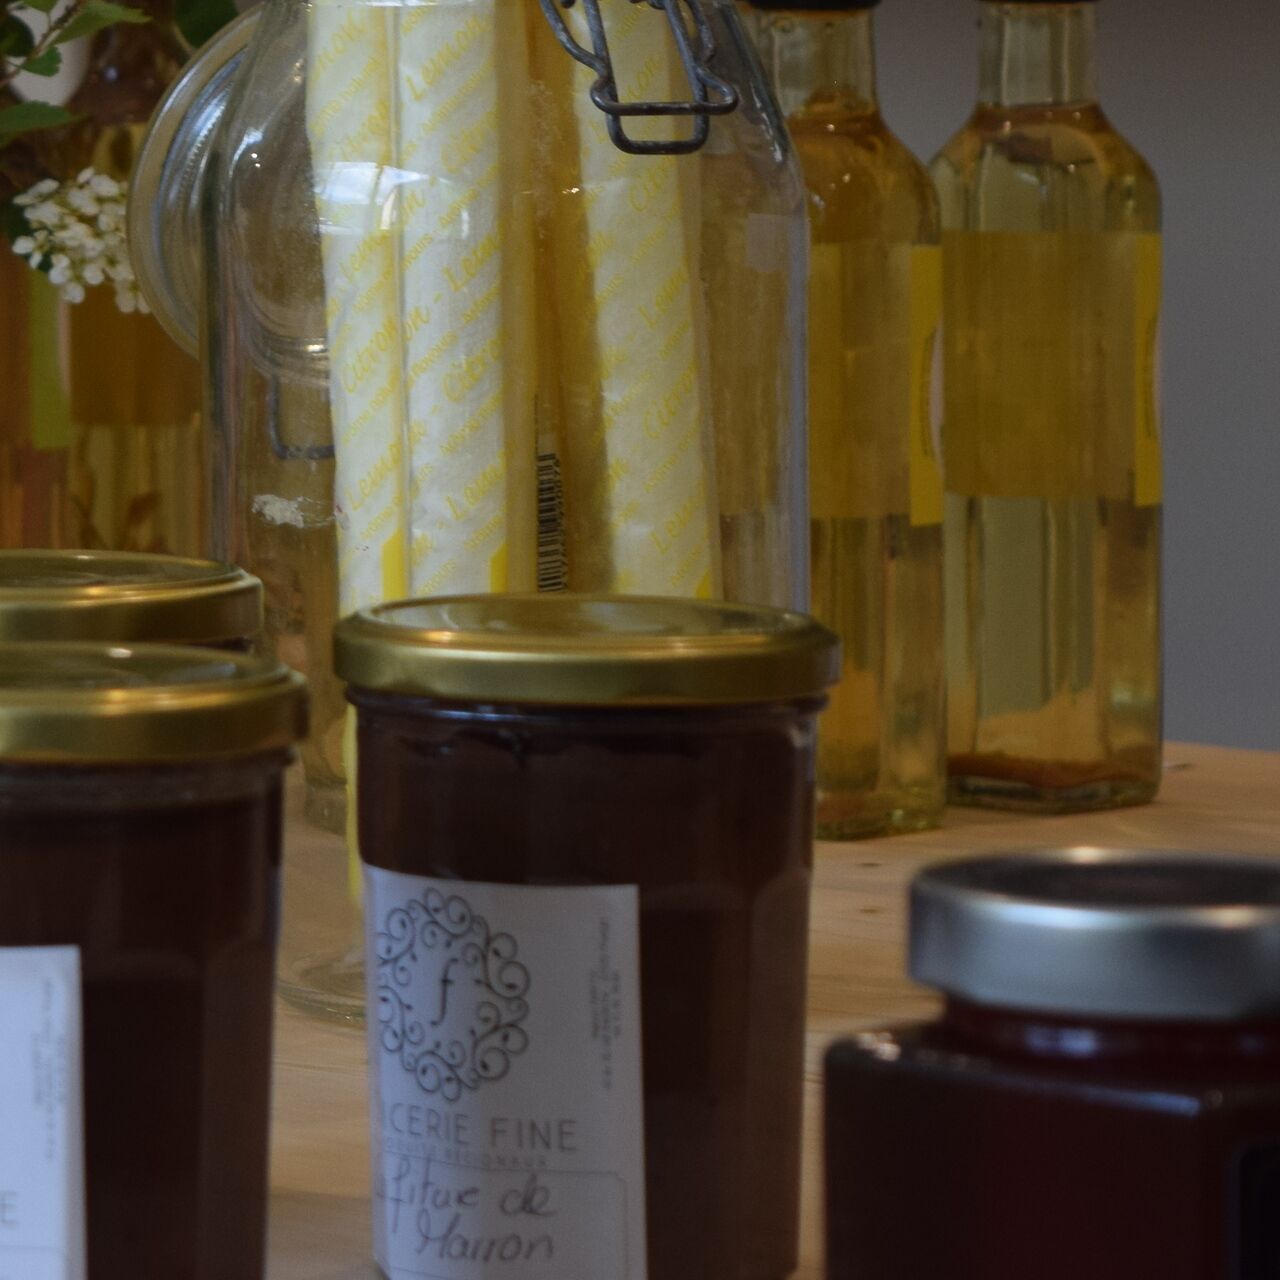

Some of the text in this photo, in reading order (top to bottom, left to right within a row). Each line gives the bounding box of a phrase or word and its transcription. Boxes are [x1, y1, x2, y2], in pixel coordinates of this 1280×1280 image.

[405, 12, 491, 102] Lemon
[388, 1102, 472, 1146] CERIE
[490, 1116, 579, 1153] FINE
[500, 1173, 559, 1218] de
